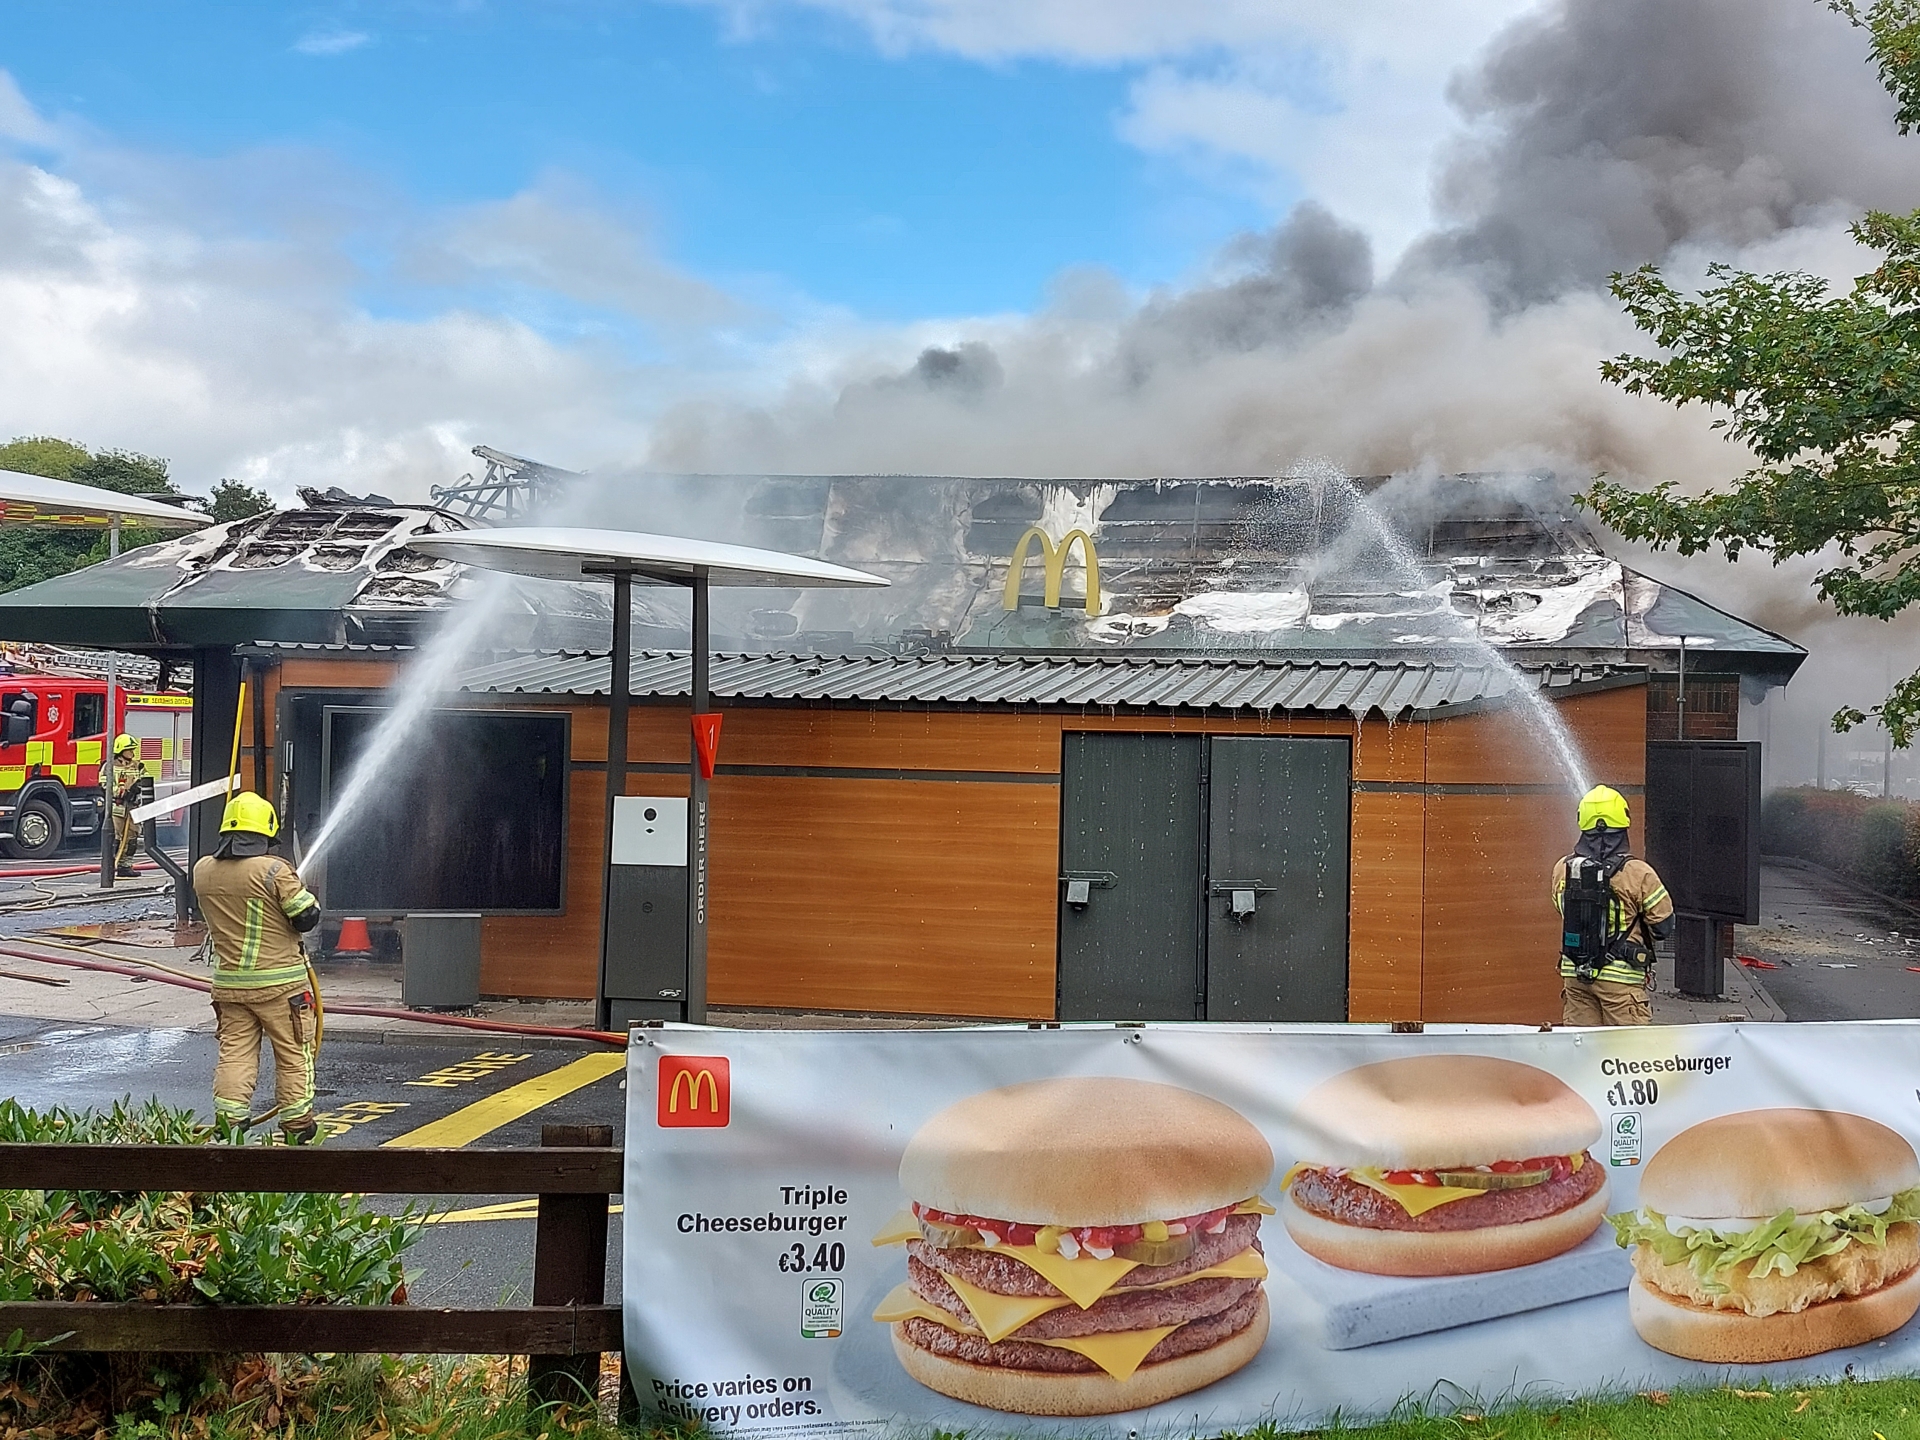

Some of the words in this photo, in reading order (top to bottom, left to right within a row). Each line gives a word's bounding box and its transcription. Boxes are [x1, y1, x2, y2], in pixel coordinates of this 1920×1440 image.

[708, 724, 715, 750] 1
[698, 800, 706, 853] HERE
[696, 855, 706, 924] ORDER
[402, 1051, 533, 1088] HERE
[1600, 1054, 1732, 1076] Cheeseburger
[1606, 1078, 1659, 1107] €1.80
[1613, 1139, 1640, 1148] QUALITY
[779, 1185, 848, 1210] Triple
[677, 1213, 848, 1236] Cheeseburger
[778, 1242, 846, 1273] €3.40
[804, 1307, 840, 1317] QUALITY
[651, 1378, 708, 1400] Price
[712, 1373, 777, 1397] varies
[782, 1376, 812, 1393] on
[657, 1398, 742, 1427] delivery
[749, 1397, 822, 1419] orders.
